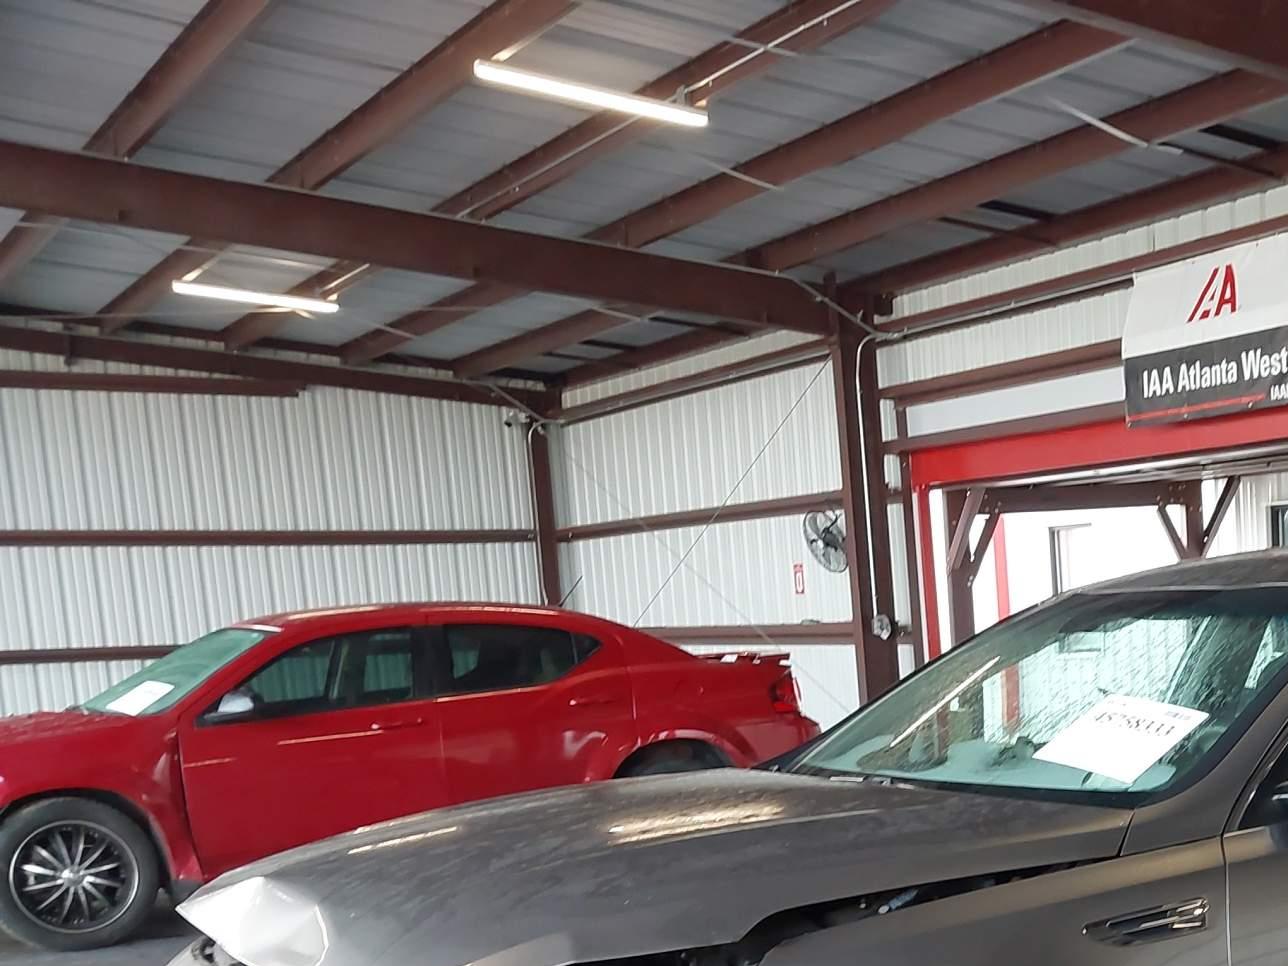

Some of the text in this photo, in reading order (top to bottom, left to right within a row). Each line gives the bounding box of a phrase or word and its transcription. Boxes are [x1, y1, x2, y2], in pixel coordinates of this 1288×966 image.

[1142, 346, 1288, 398] IAA Atlanta West
